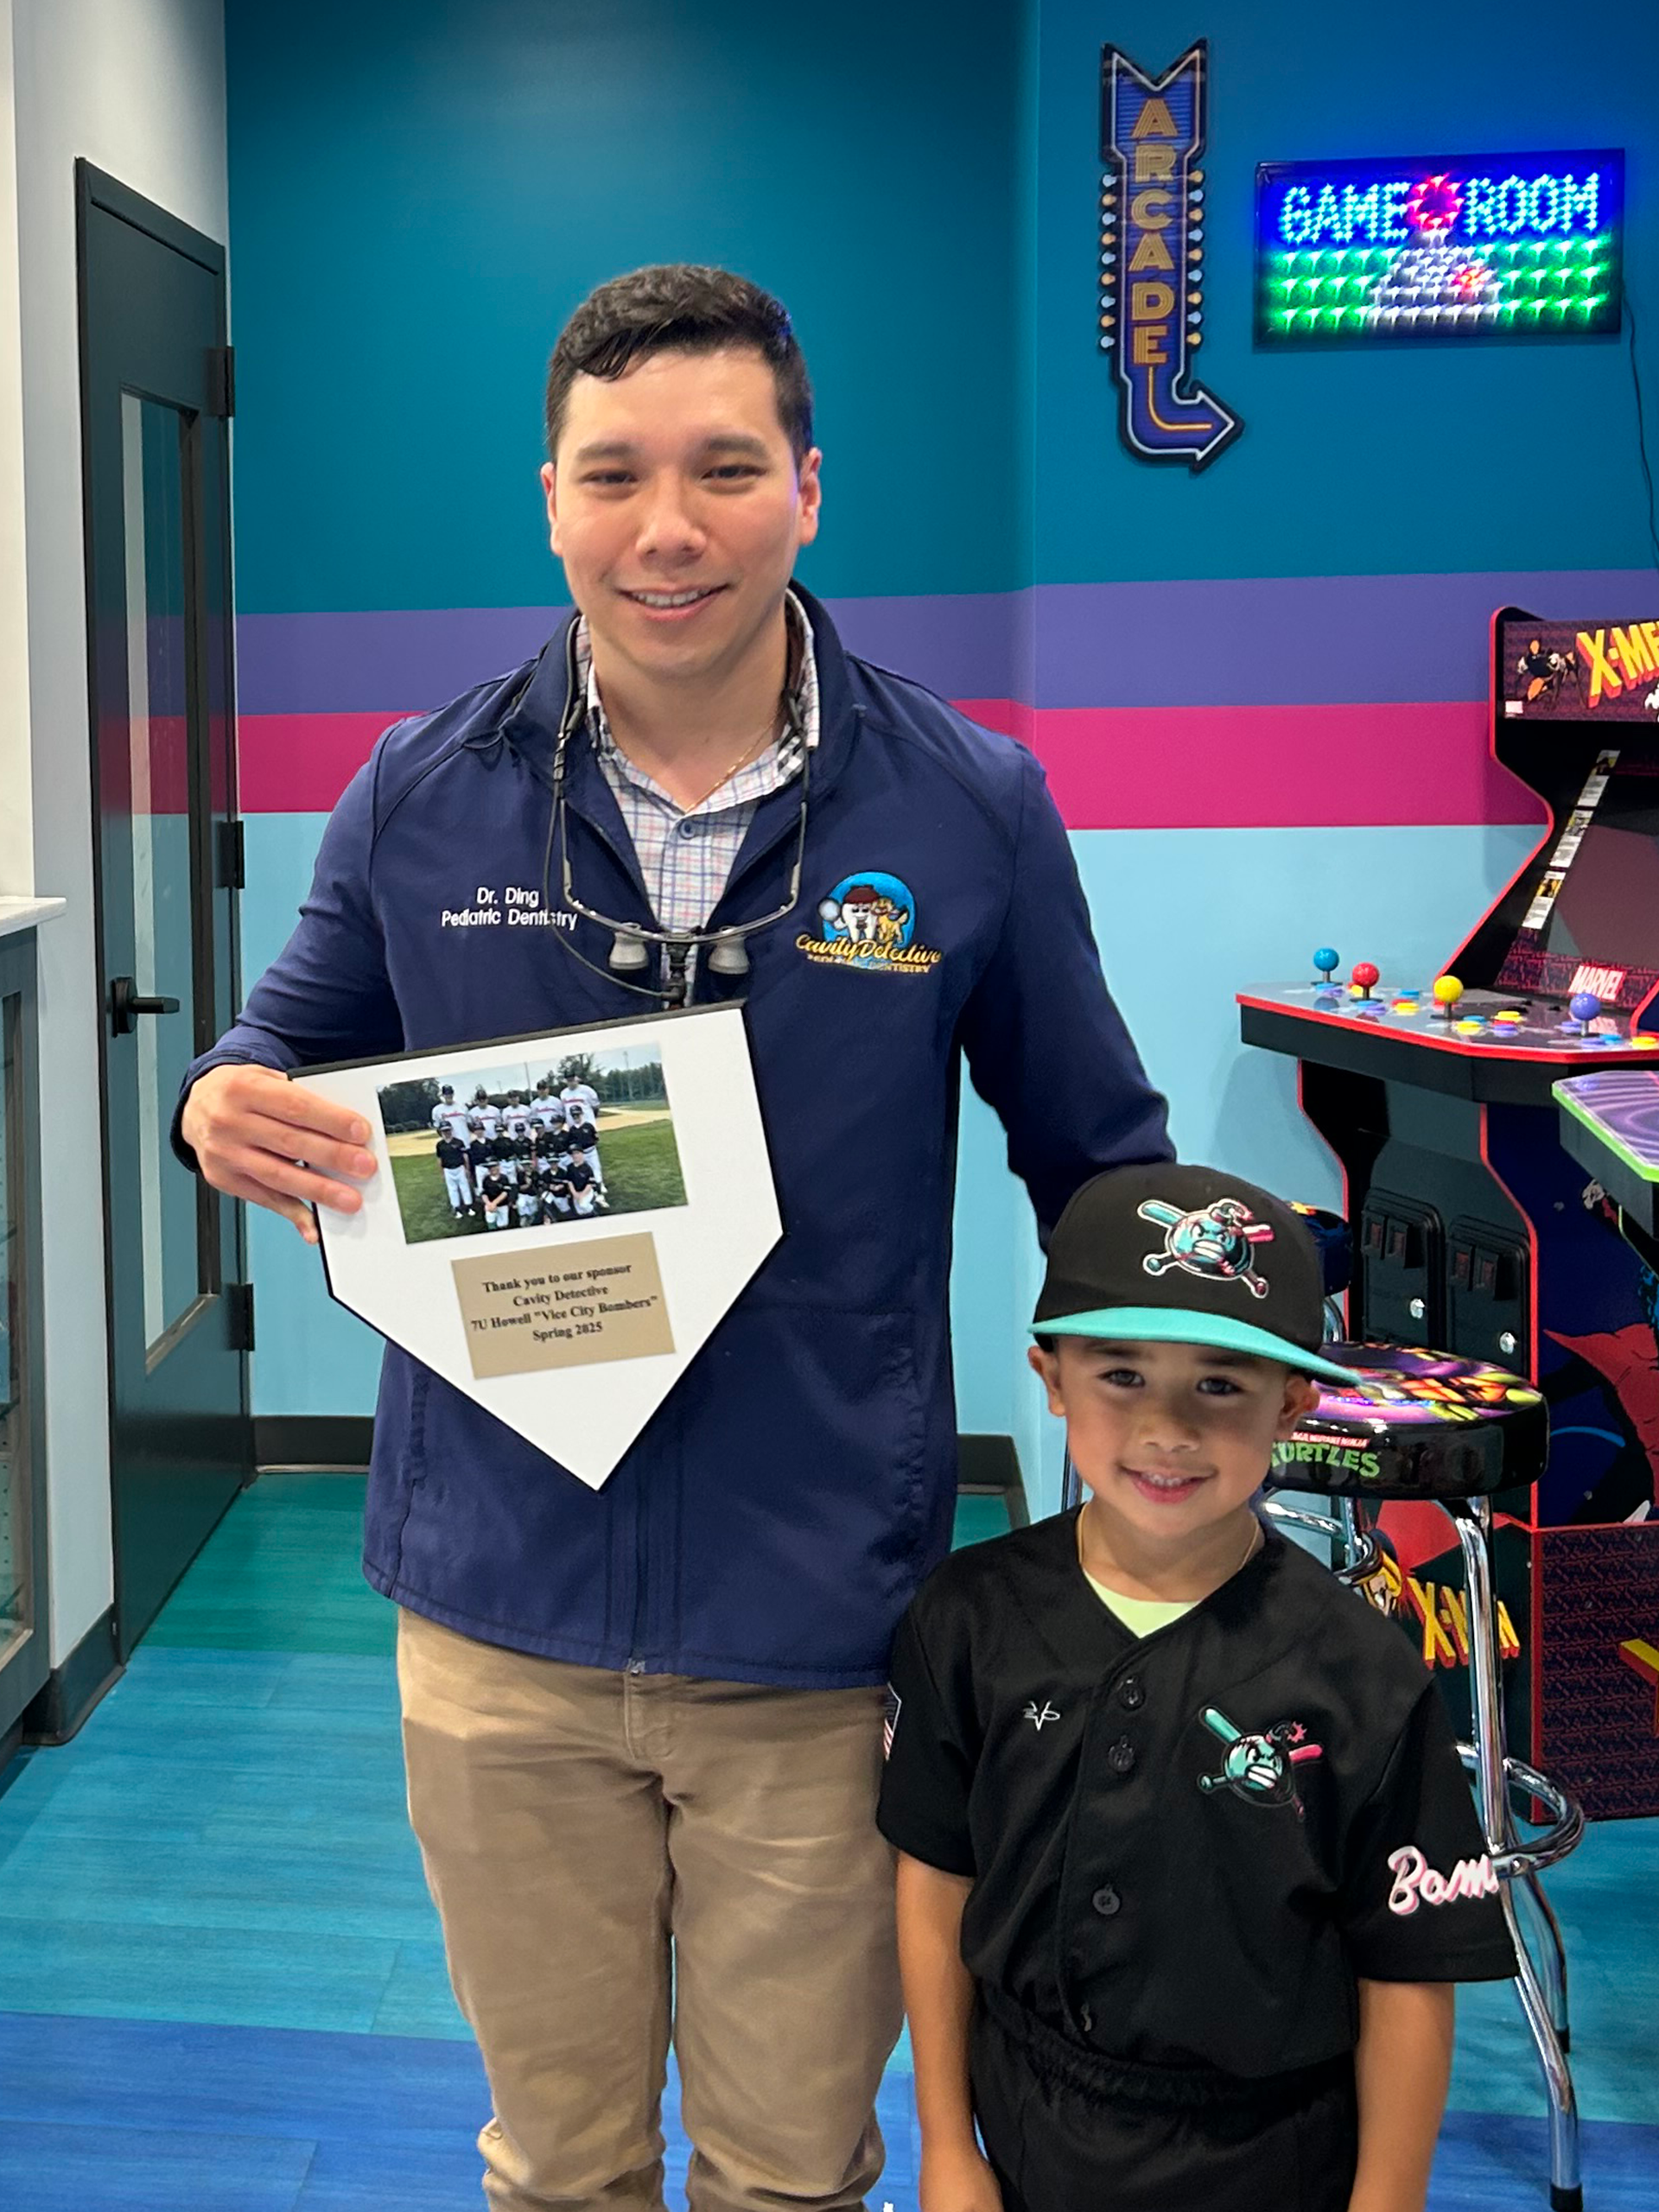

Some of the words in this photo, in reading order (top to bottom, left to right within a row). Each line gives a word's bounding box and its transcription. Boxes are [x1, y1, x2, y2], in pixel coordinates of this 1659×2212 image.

[1280, 181, 1411, 244] GAME
[1465, 173, 1599, 236] ROOM
[1128, 99, 1178, 364] ARCADE
[1576, 621, 1659, 709] X-ME
[476, 887, 499, 905] Dr.
[505, 887, 540, 908] Ding
[442, 908, 502, 927] Pediatric
[1567, 964, 1626, 1001] MARVEL
[481, 1279, 521, 1294] Thank
[524, 1276, 546, 1291] you
[548, 1274, 561, 1284] to
[563, 1270, 583, 1281] our
[586, 1264, 632, 1281] sponsor
[512, 1292, 551, 1307] Cavity
[554, 1285, 609, 1302] Detective
[471, 1319, 488, 1331] 7U
[490, 1312, 532, 1329] Howell
[533, 1310, 567, 1323] "Vice
[569, 1304, 596, 1318] City
[598, 1295, 658, 1314] Bombers"
[532, 1325, 573, 1343] Spring
[575, 1321, 603, 1335] 2025
